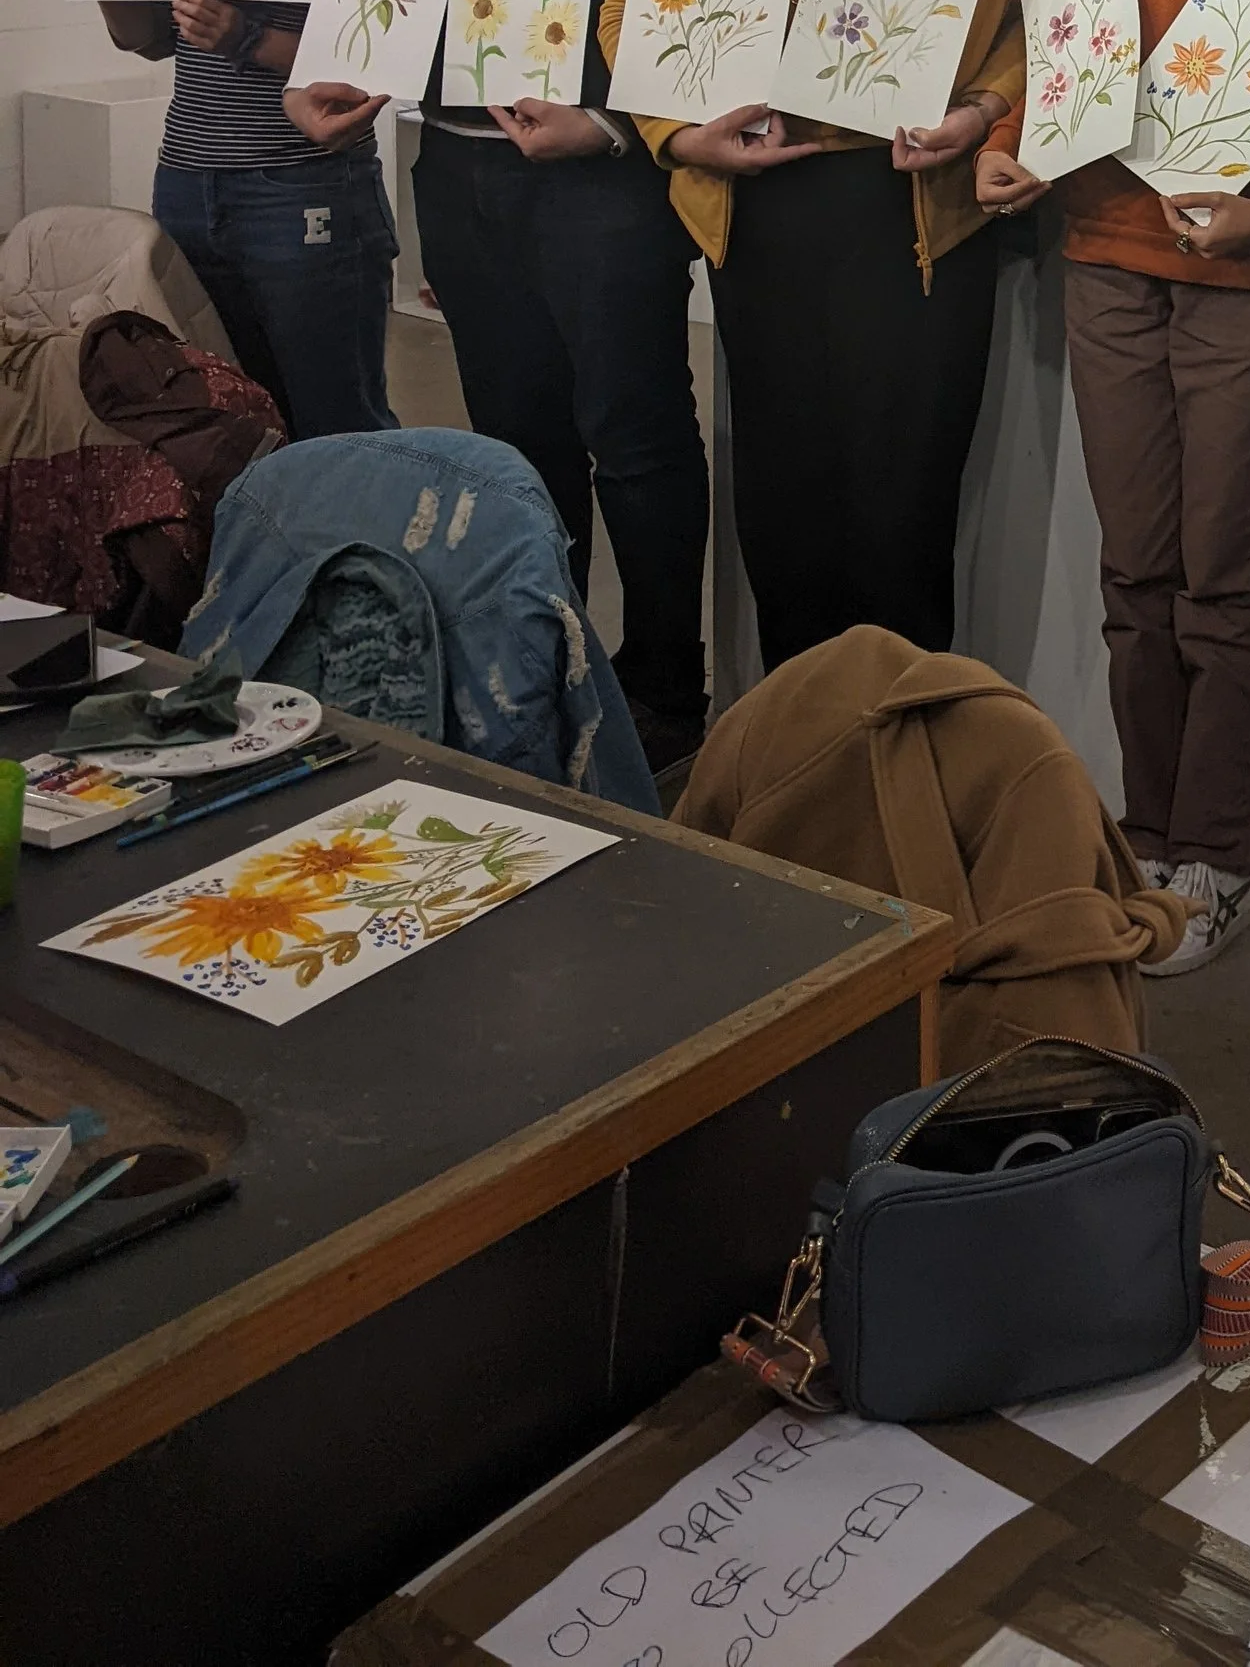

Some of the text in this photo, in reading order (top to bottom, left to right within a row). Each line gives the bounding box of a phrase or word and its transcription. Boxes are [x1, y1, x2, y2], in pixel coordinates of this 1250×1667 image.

[303, 206, 332, 245] E
[691, 1557, 767, 1608] BE
[726, 1483, 923, 1667] OLLECTED
[547, 1565, 647, 1658] OLD
